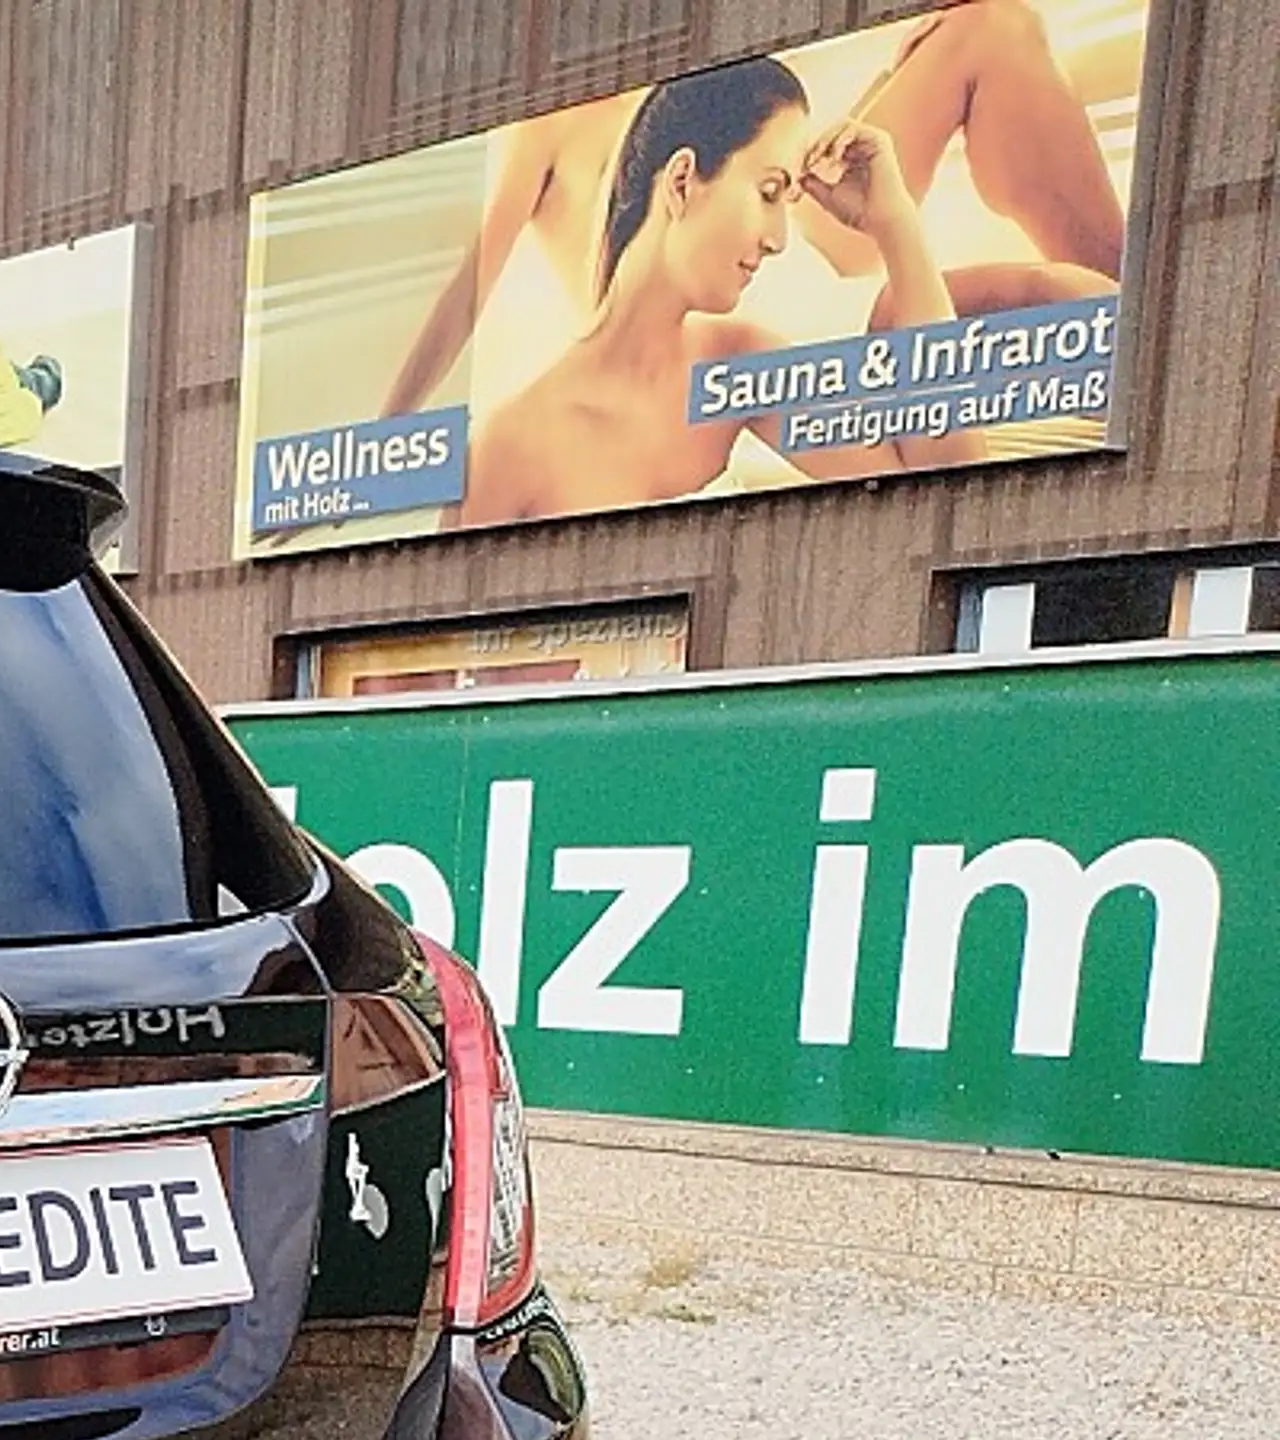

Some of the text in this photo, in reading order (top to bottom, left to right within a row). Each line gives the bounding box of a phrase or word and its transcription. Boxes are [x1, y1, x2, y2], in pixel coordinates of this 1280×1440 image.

[700, 306, 1115, 415] Sauna & Infrarot
[787, 371, 1107, 447] Fertigung auf Maß
[268, 428, 449, 491] Wellness
[265, 496, 298, 523] mit
[798, 766, 1221, 1064] im
